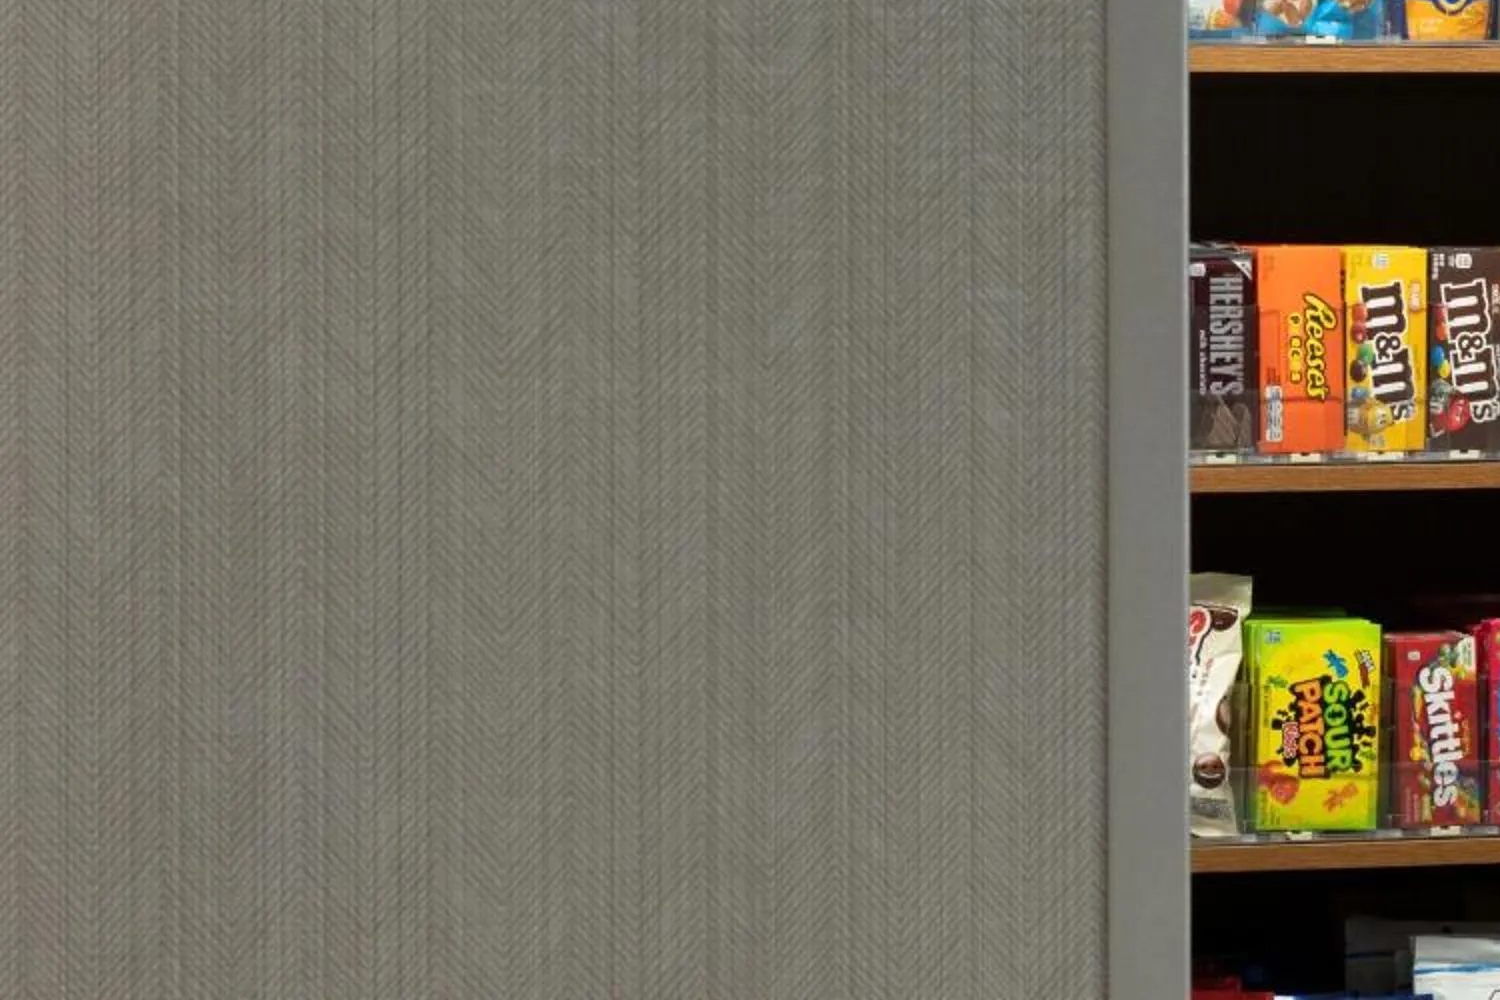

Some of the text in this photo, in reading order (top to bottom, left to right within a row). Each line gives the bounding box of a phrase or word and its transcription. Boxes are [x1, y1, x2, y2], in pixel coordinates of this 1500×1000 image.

[1209, 277, 1244, 396] HERSHEY'S
[1303, 293, 1337, 402] Reese's
[1295, 679, 1325, 777] PATCH
[1323, 681, 1351, 772] SOUR
[1419, 666, 1463, 807] Skittles
